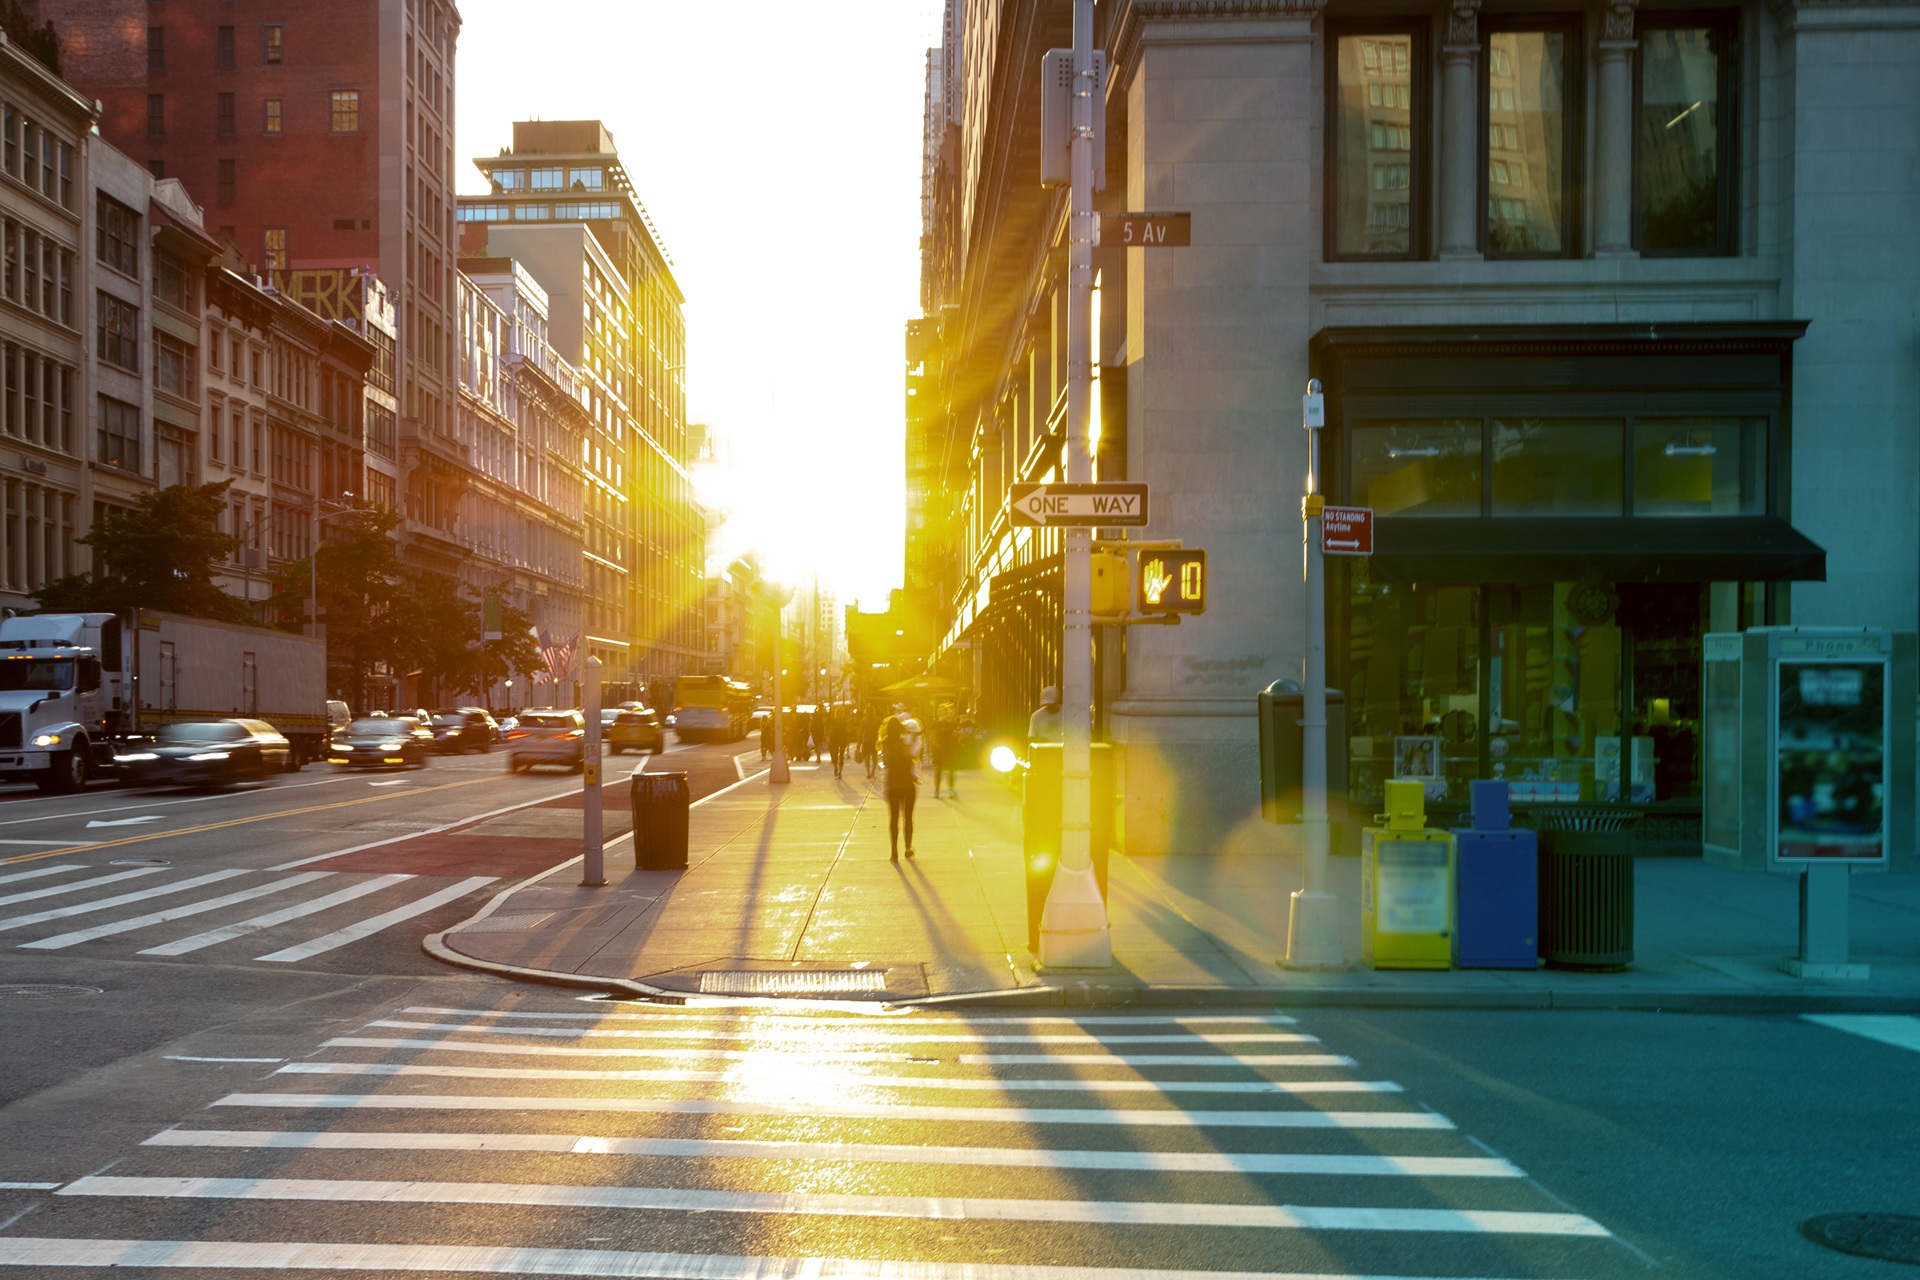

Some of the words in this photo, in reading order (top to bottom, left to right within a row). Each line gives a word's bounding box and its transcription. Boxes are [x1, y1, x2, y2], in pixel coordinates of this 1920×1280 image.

[1123, 221, 1133, 243] 5
[1142, 222, 1166, 243] Av
[1028, 497, 1069, 514] ONE
[1092, 496, 1136, 514] WAY
[1325, 511, 1334, 521] NO
[1335, 512, 1365, 523] STANDING
[1325, 522, 1351, 533] Anytime
[1181, 561, 1201, 600] 10
[1805, 639, 1854, 651] Phone
